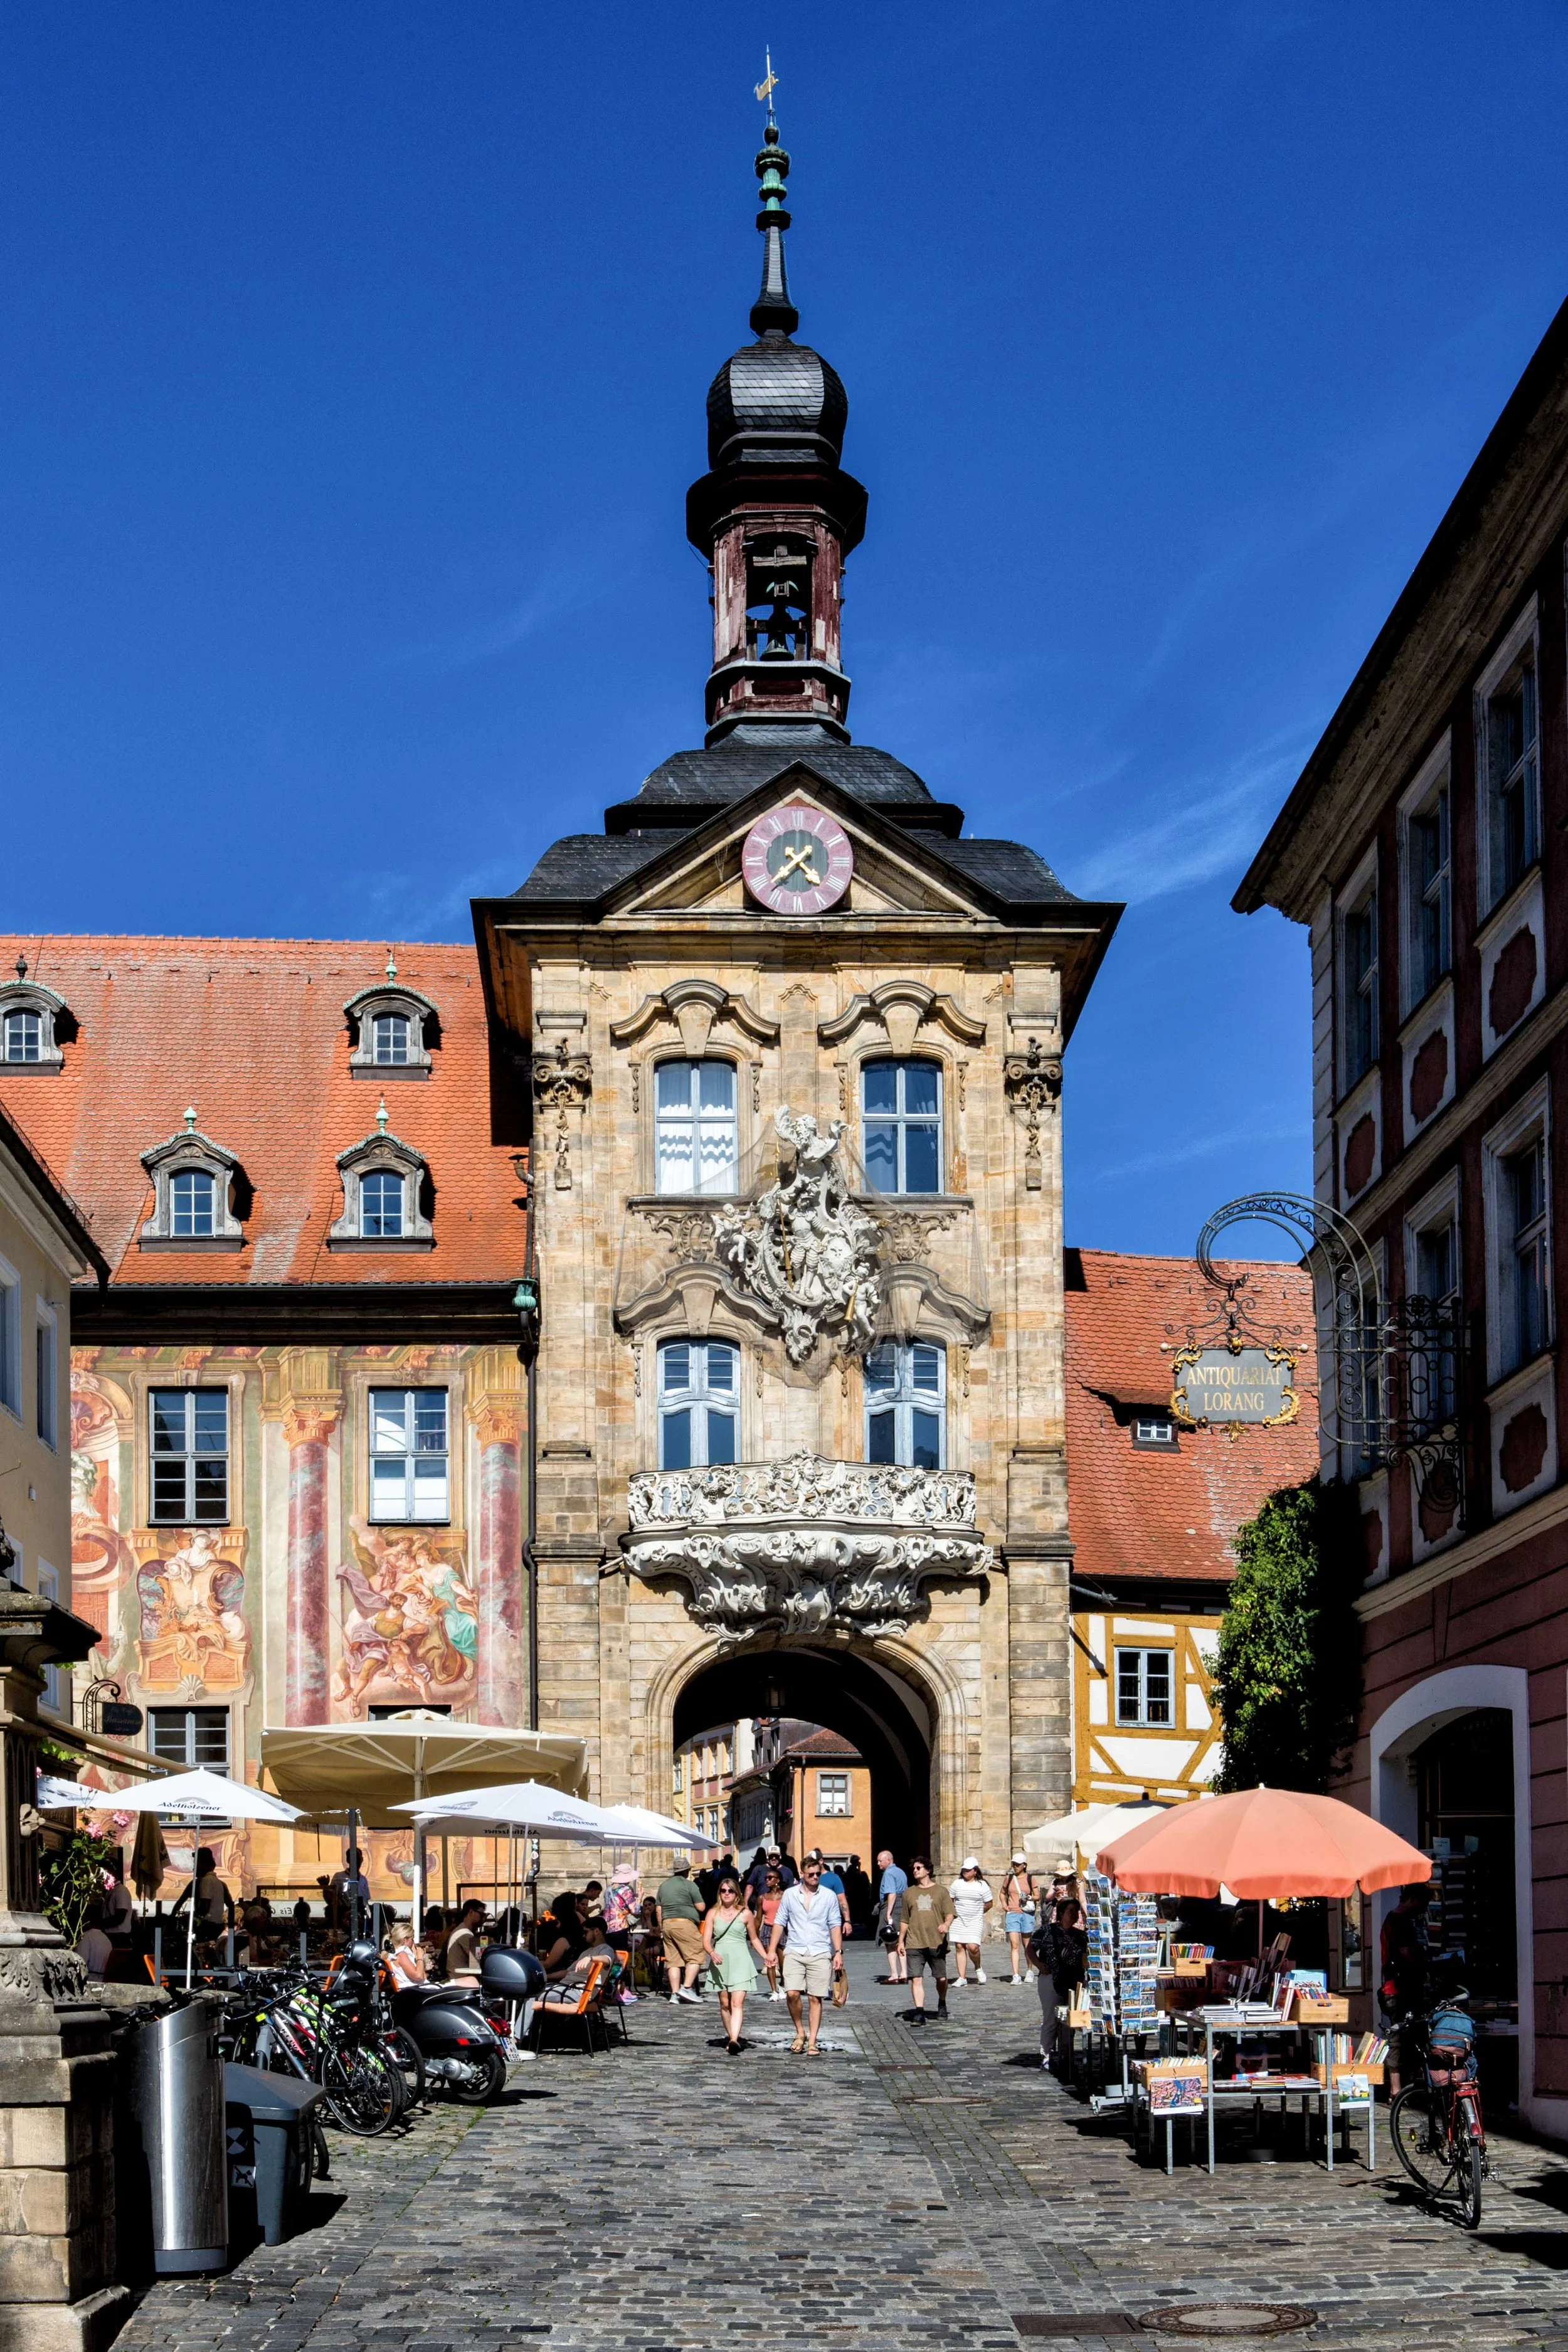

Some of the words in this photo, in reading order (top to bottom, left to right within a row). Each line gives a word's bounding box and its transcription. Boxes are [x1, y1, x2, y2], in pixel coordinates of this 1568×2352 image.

[768, 815, 783, 834] XI
[791, 810, 805, 827] XII
[813, 817, 826, 832] I
[751, 833, 770, 847] X
[826, 833, 845, 847] II
[745, 855, 763, 866] IX
[832, 857, 850, 867] III
[825, 874, 845, 893] IIII
[767, 889, 783, 908] VII
[793, 896, 803, 913] VI
[814, 891, 827, 908] V
[1186, 1367, 1282, 1389] ANTIQUARIAT
[1204, 1392, 1264, 1411] LORANG
[157, 1802, 223, 1811] Adelholzener
